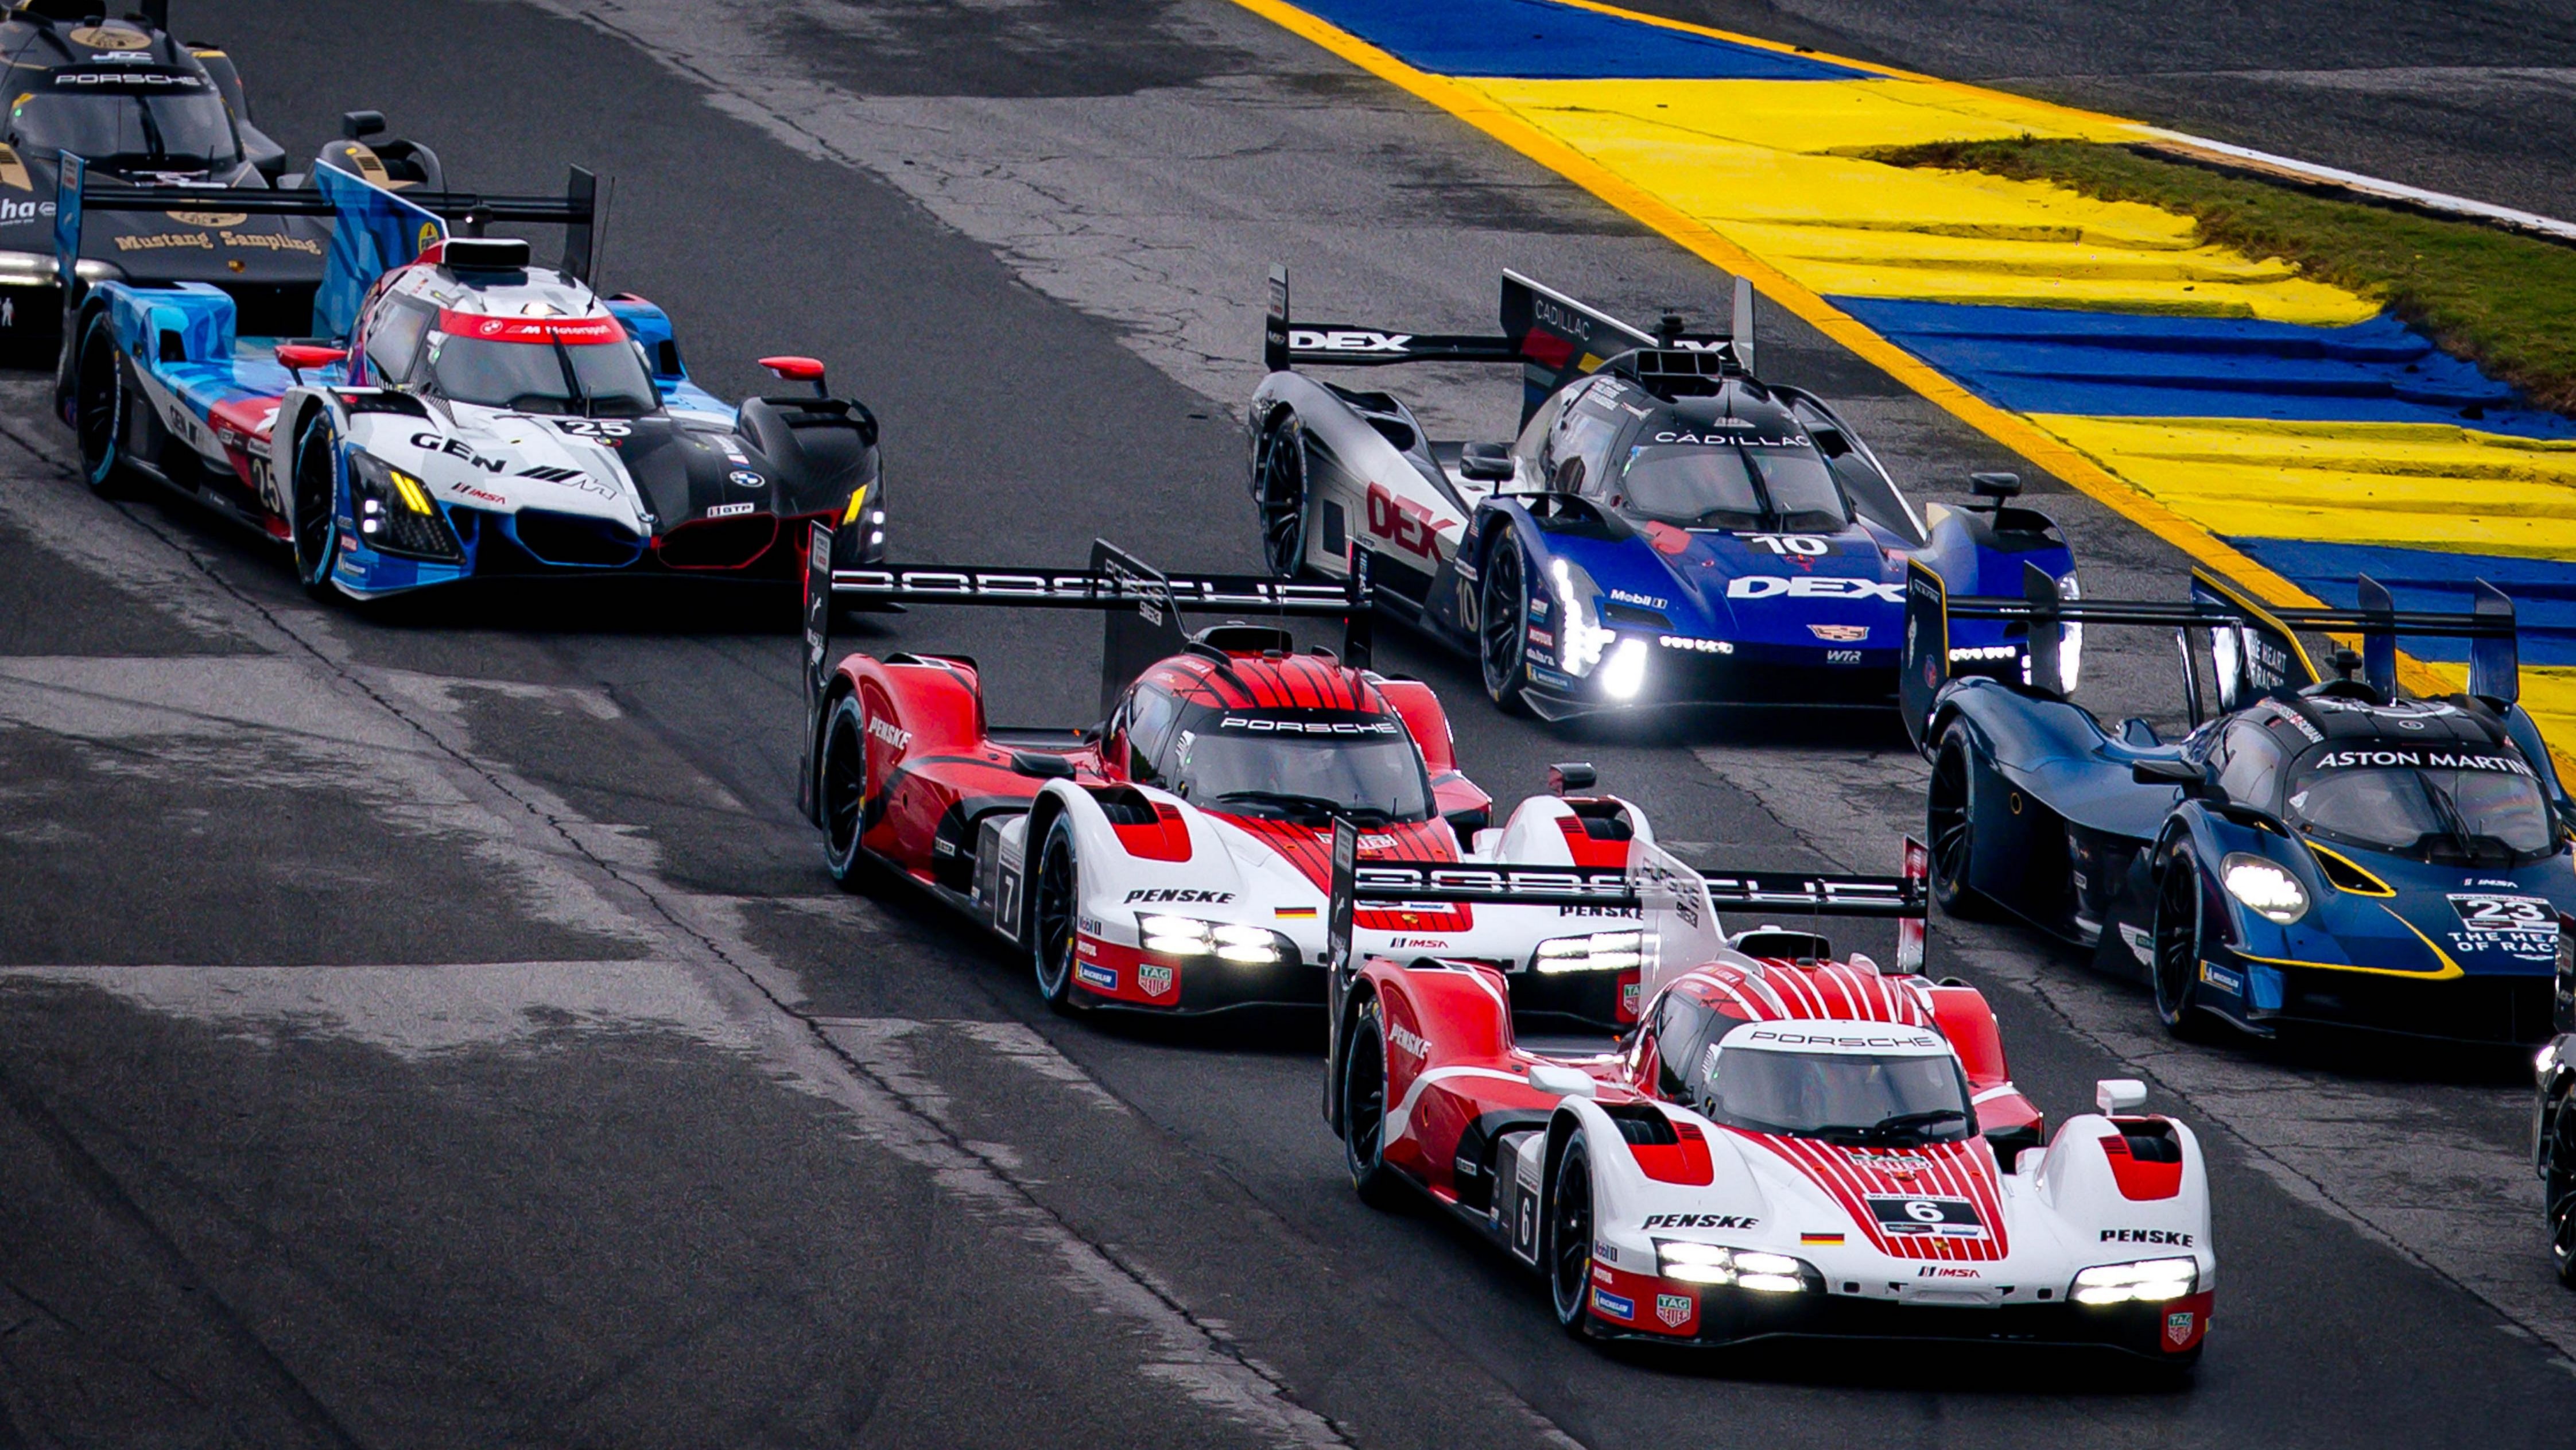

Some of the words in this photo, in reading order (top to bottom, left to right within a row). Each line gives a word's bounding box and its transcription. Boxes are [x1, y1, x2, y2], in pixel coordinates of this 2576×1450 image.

[55, 73, 201, 86] PORSCHE
[115, 231, 214, 251] Mustang
[219, 230, 321, 255] Sampling
[1535, 299, 1590, 342] CADILLAC
[1289, 331, 1413, 352] DEX
[567, 422, 632, 437] 25
[1655, 432, 1812, 447] CADILLAC
[410, 432, 506, 474] GEN
[253, 458, 280, 513] 25
[468, 488, 506, 505] IMSA
[1366, 481, 1457, 563] DEX
[1752, 536, 1828, 555] 10
[1610, 589, 1652, 606] Mobil
[1727, 575, 1907, 603] DEX
[1456, 577, 1478, 631] 10
[1139, 600, 1163, 627] 963
[1828, 650, 1861, 661] WTR
[2262, 643, 2287, 673] HEART
[868, 715, 912, 750] PENSKE
[1220, 717, 1398, 734] PORSCHE
[2317, 753, 2419, 769] ASTON
[2430, 753, 2537, 778] MARTIN
[1005, 874, 1014, 922] 7
[1123, 889, 1236, 904] PENSKE
[1676, 901, 1698, 929] 963
[2467, 899, 2545, 920] 23
[1408, 940, 1449, 949] IMSA
[2447, 932, 2501, 943] THE
[2511, 933, 2559, 943] HEA
[2458, 942, 2490, 951] OF
[2502, 943, 2558, 952] RAC
[1143, 966, 1169, 979] TAG
[1140, 977, 1170, 995] HEUER
[1628, 984, 1640, 995] TA
[1388, 1022, 1432, 1060] PENSKE
[1751, 1031, 1936, 1047] PORSCHE
[1904, 1201, 1945, 1222] 6
[1522, 1197, 1530, 1246] 6
[1641, 1213, 1759, 1231] PENSKE
[2100, 1229, 2195, 1248] PENSKE
[1938, 1268, 1981, 1278] IMSA
[1600, 1296, 1629, 1312] MICHELIN
[1660, 1296, 1687, 1308] TAG
[1658, 1308, 1689, 1325] HEUER
[2170, 1315, 2191, 1326] TAG
